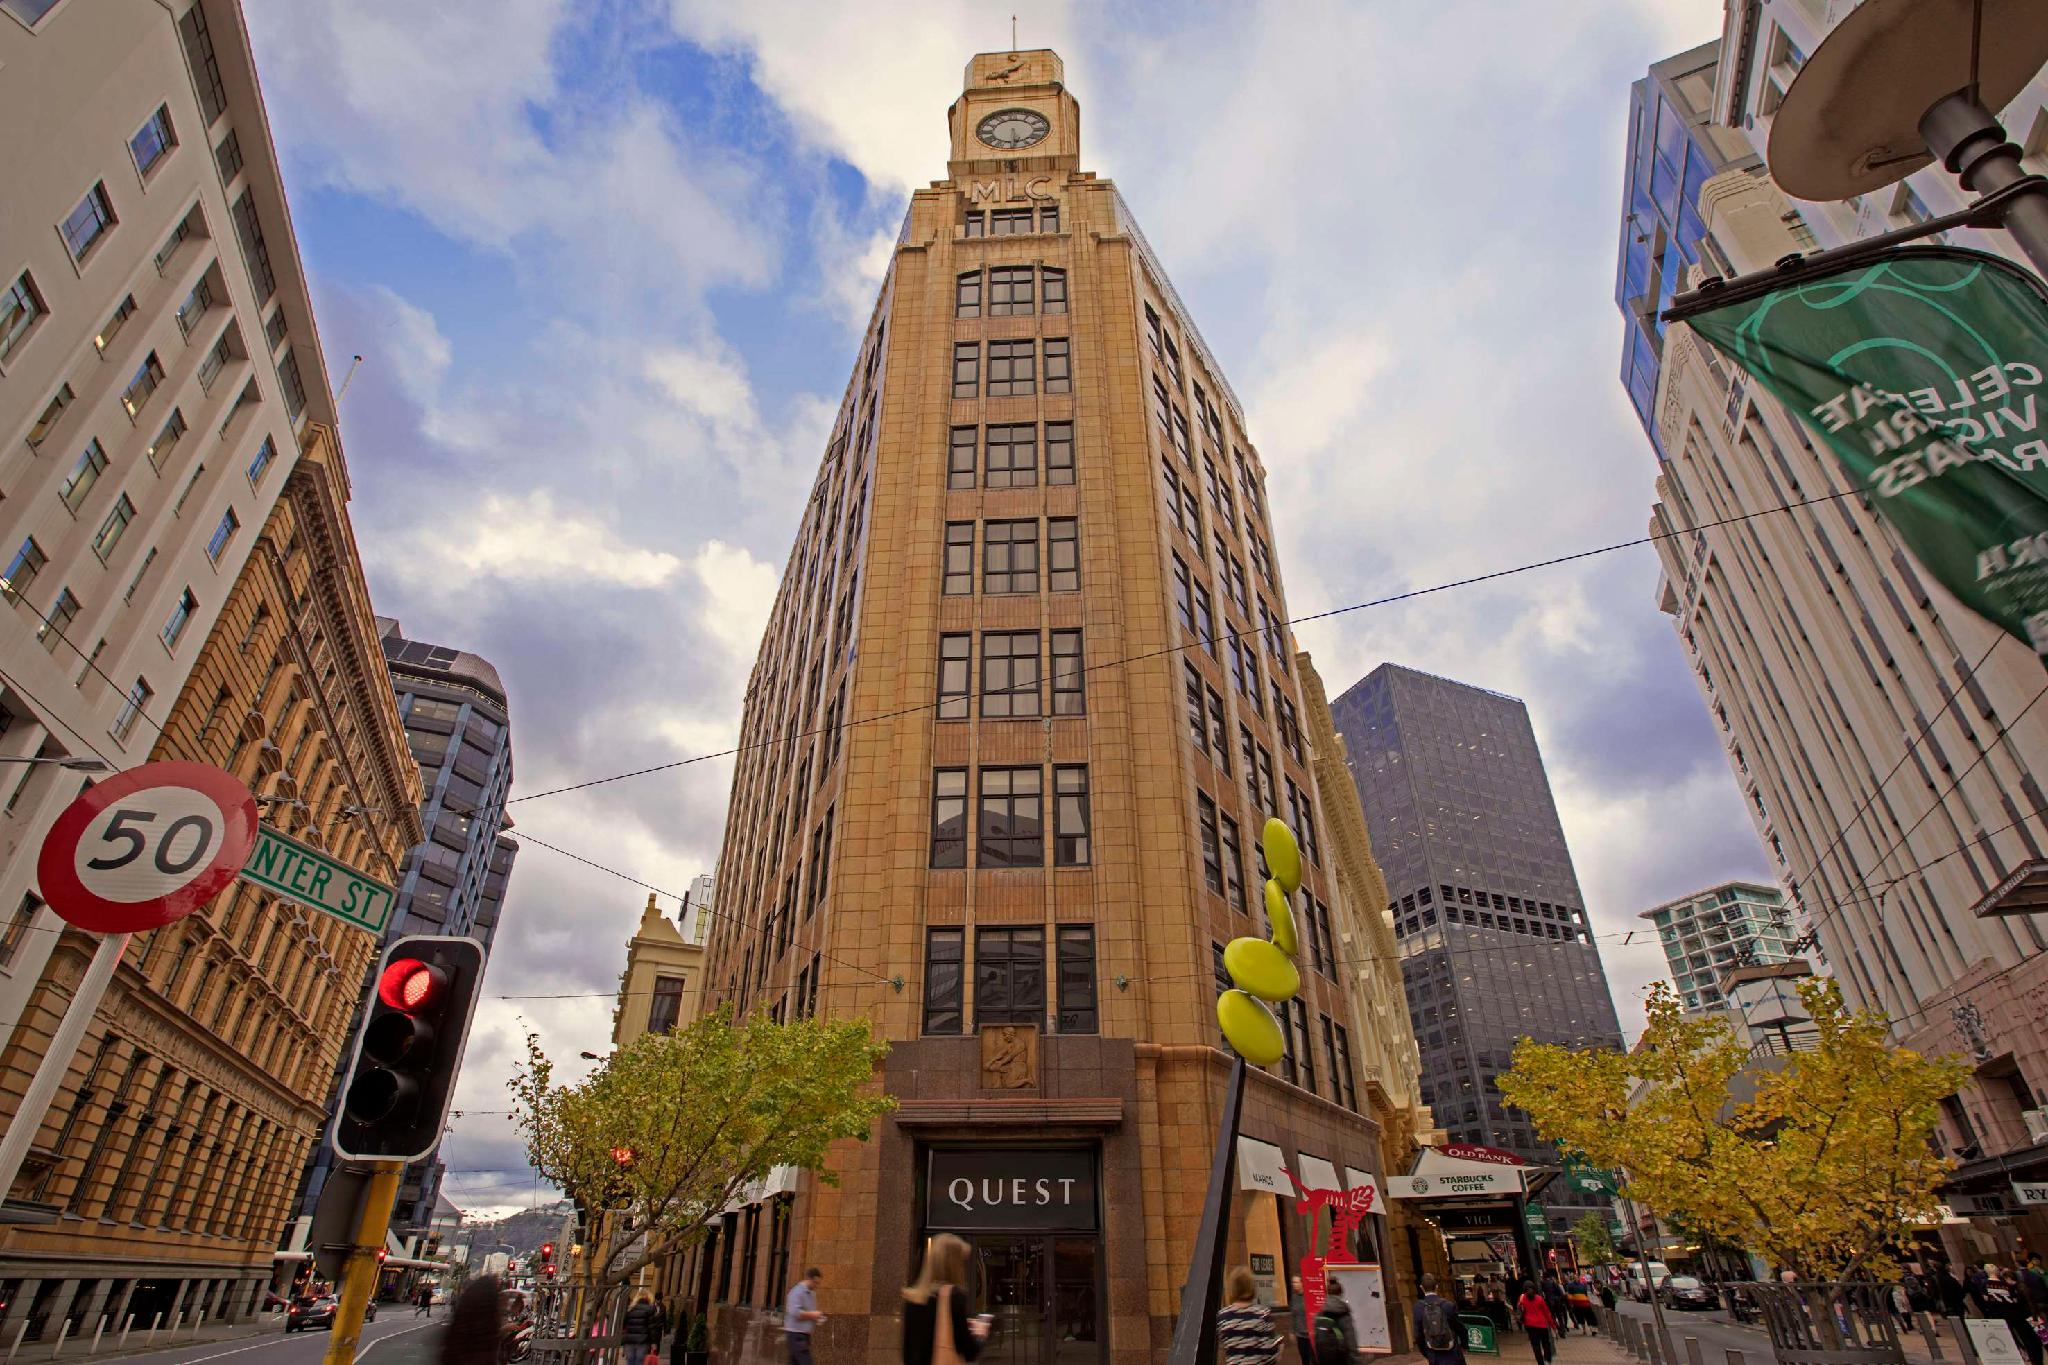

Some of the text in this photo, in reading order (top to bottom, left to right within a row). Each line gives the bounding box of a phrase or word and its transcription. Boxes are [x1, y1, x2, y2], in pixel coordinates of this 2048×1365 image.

[971, 176, 1053, 204] MLC
[87, 809, 213, 875] 50
[252, 838, 379, 919] NTER ST
[1448, 1148, 1513, 1165] OLD BANK
[1440, 1175, 1494, 1185] STARBUCKS
[1452, 1184, 1485, 1192] COFFEE
[948, 1178, 1076, 1211] QUEST
